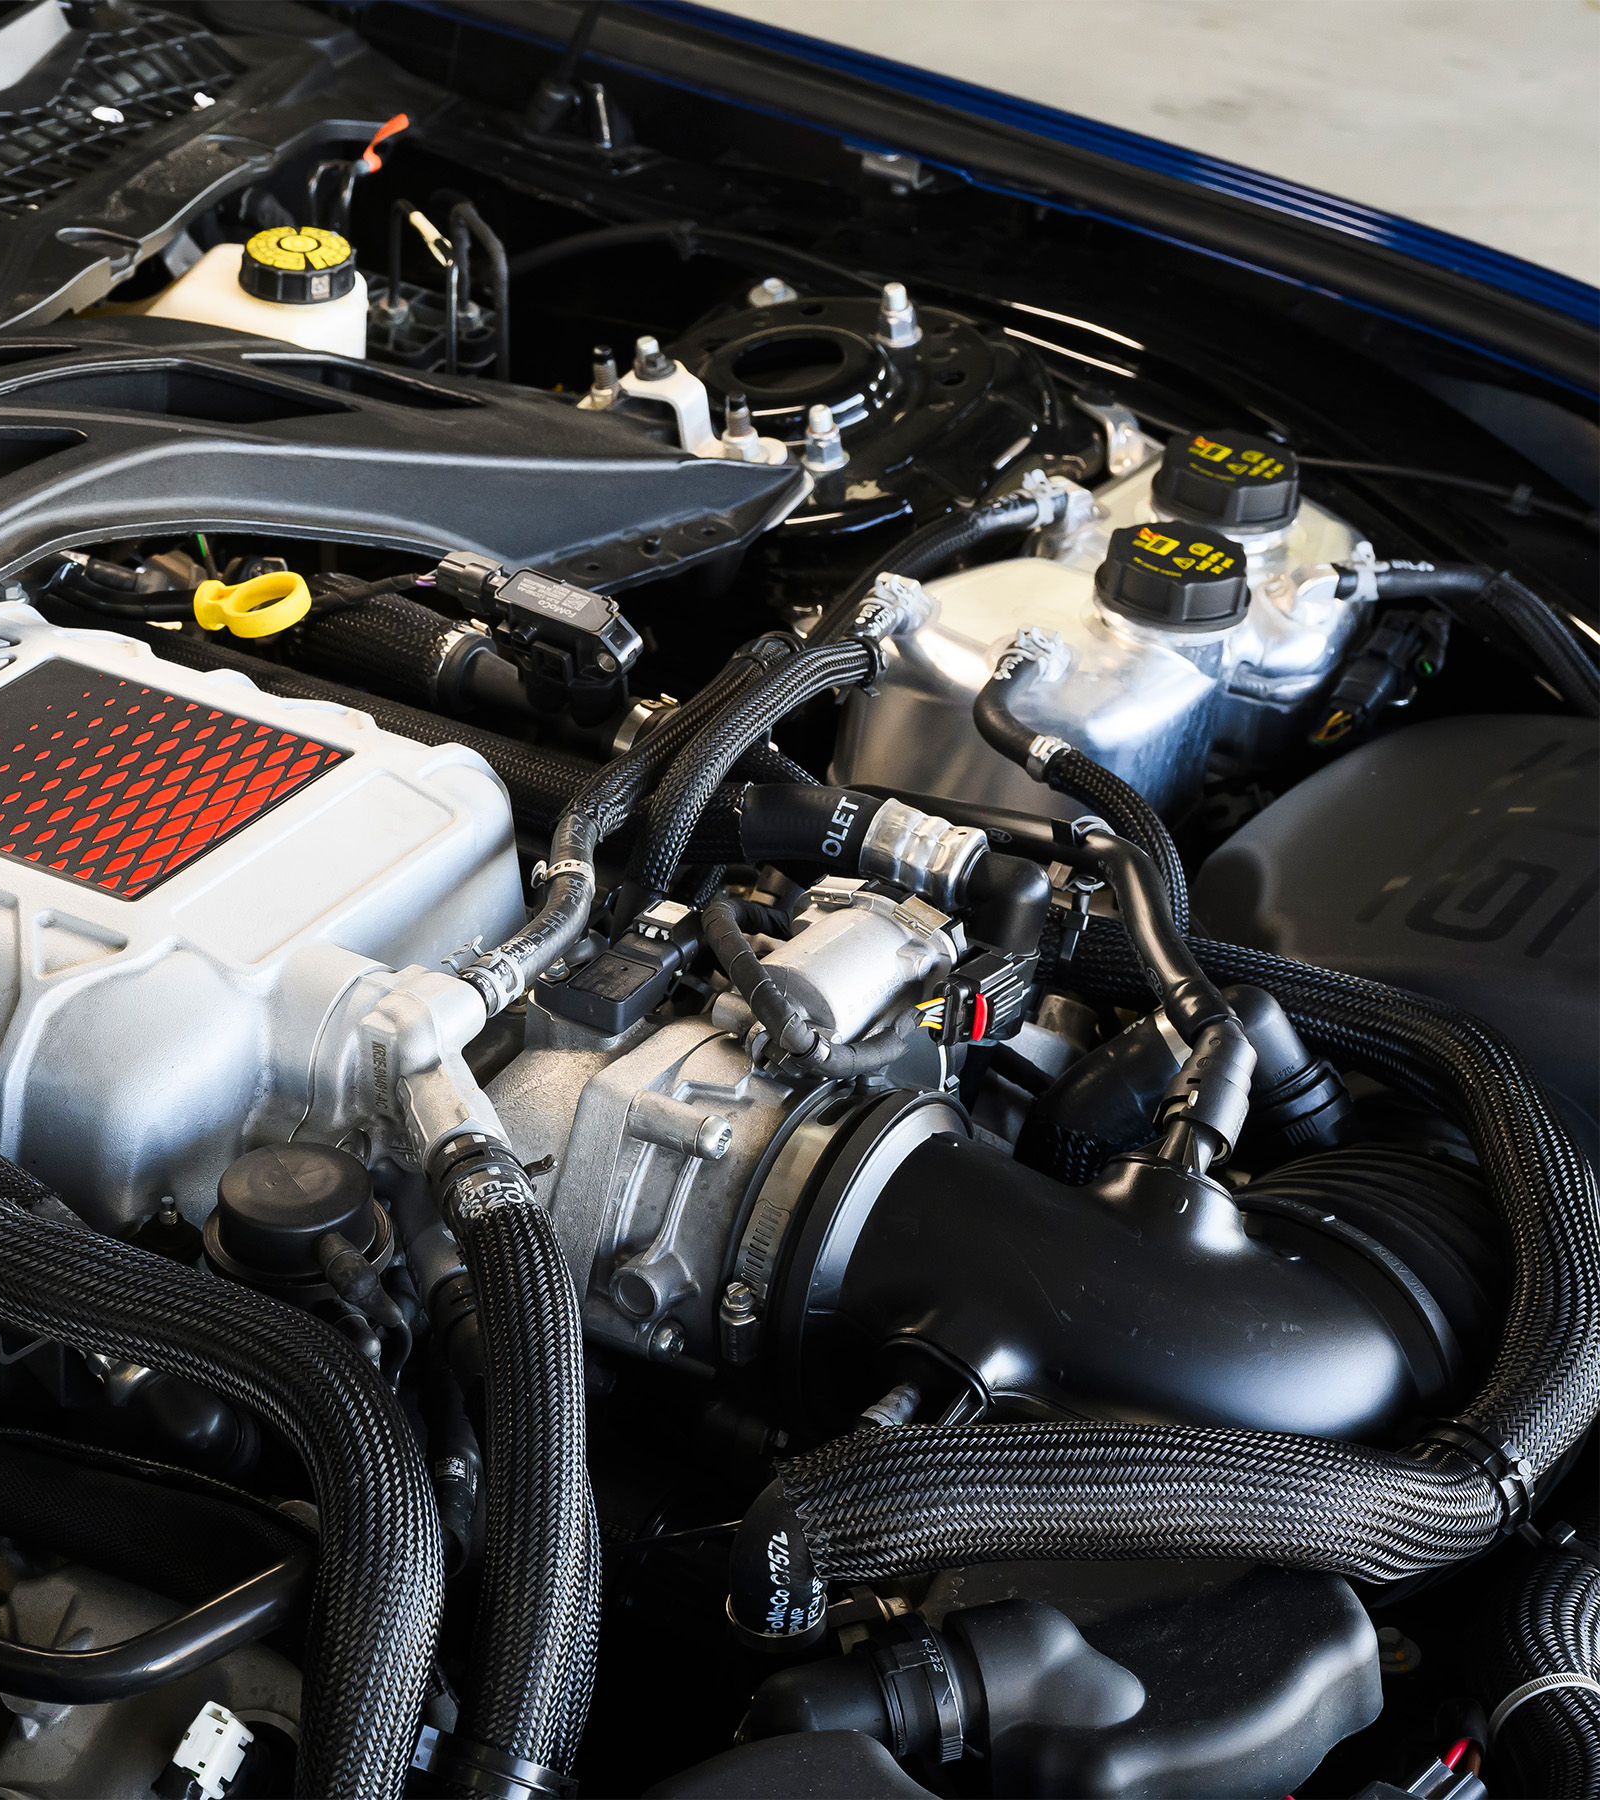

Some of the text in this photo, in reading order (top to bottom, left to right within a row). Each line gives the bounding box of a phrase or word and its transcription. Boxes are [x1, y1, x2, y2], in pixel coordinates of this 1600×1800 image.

[537, 599, 578, 619] FoMoCo
[822, 796, 859, 858] OLET
[476, 1180, 507, 1211] EN
